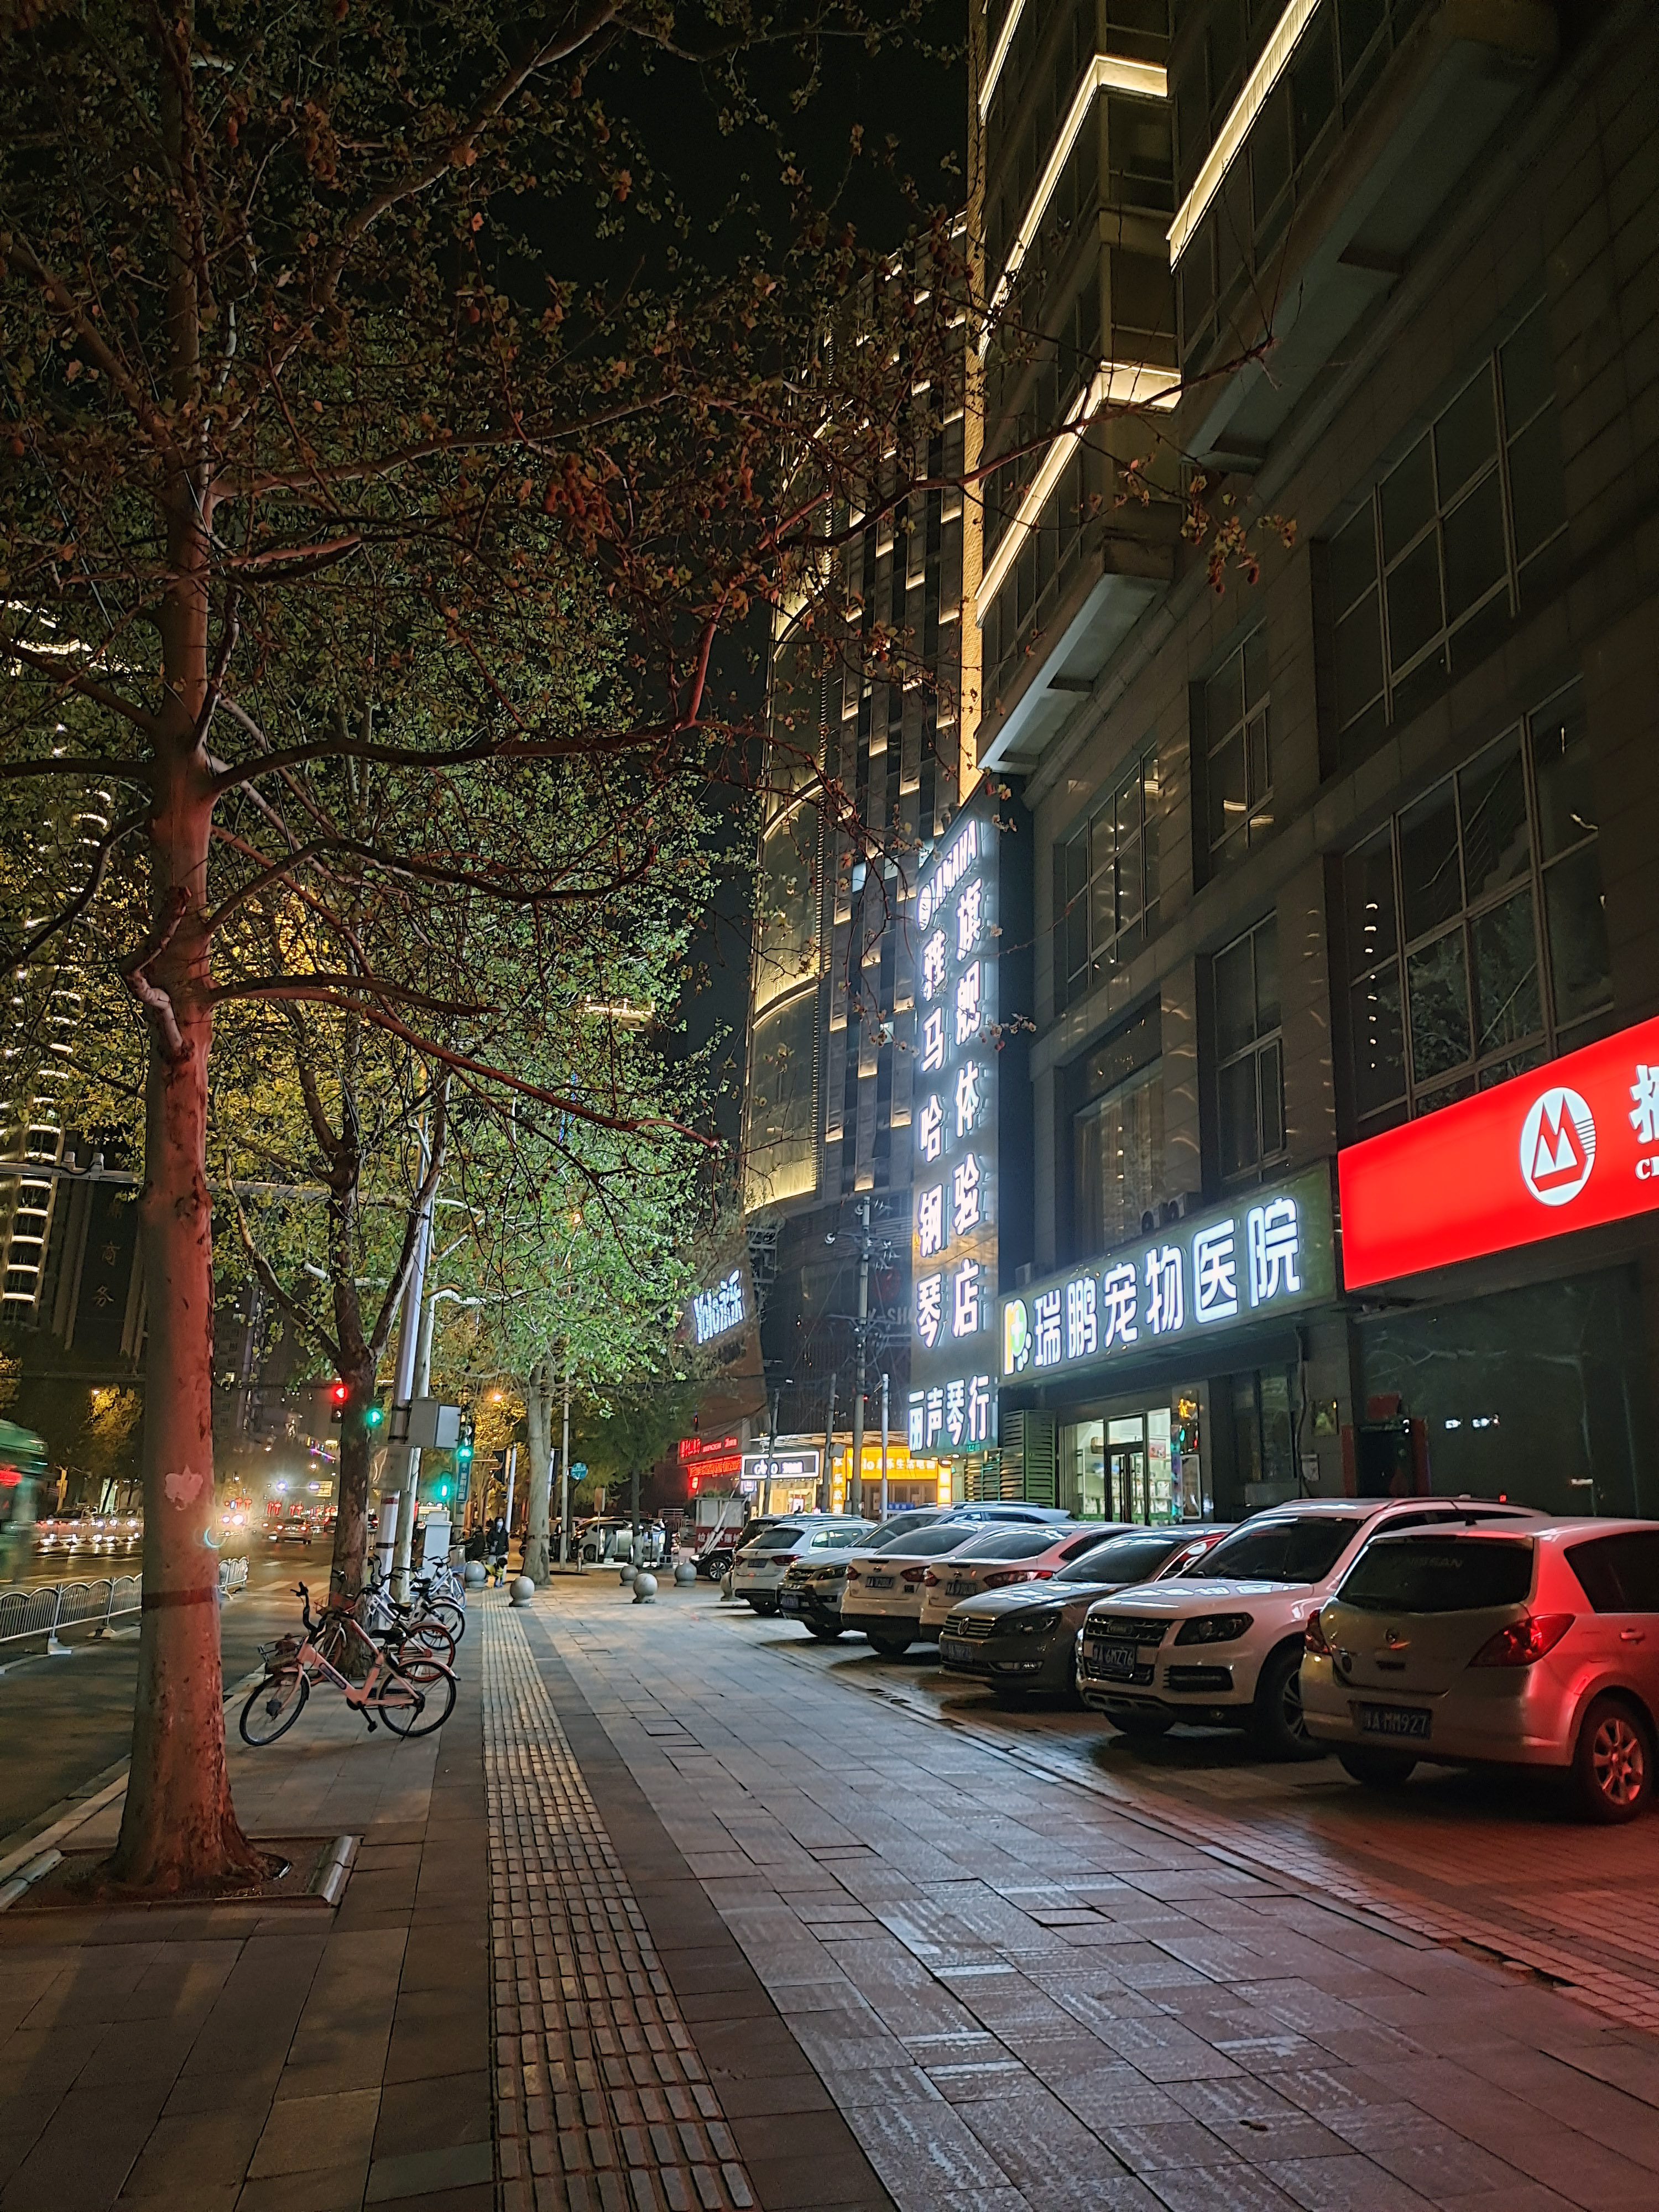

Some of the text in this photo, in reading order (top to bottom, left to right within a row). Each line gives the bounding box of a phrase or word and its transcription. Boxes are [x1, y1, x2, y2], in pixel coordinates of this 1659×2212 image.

[930, 819, 977, 914] YAMAHA
[917, 928, 946, 1348] 雅马哈钢琴
[952, 877, 982, 1338] 旗舰体验店
[1033, 1197, 1301, 1367] 瑞鹏宠物医院
[909, 1375, 990, 1451] 丽声琴行
